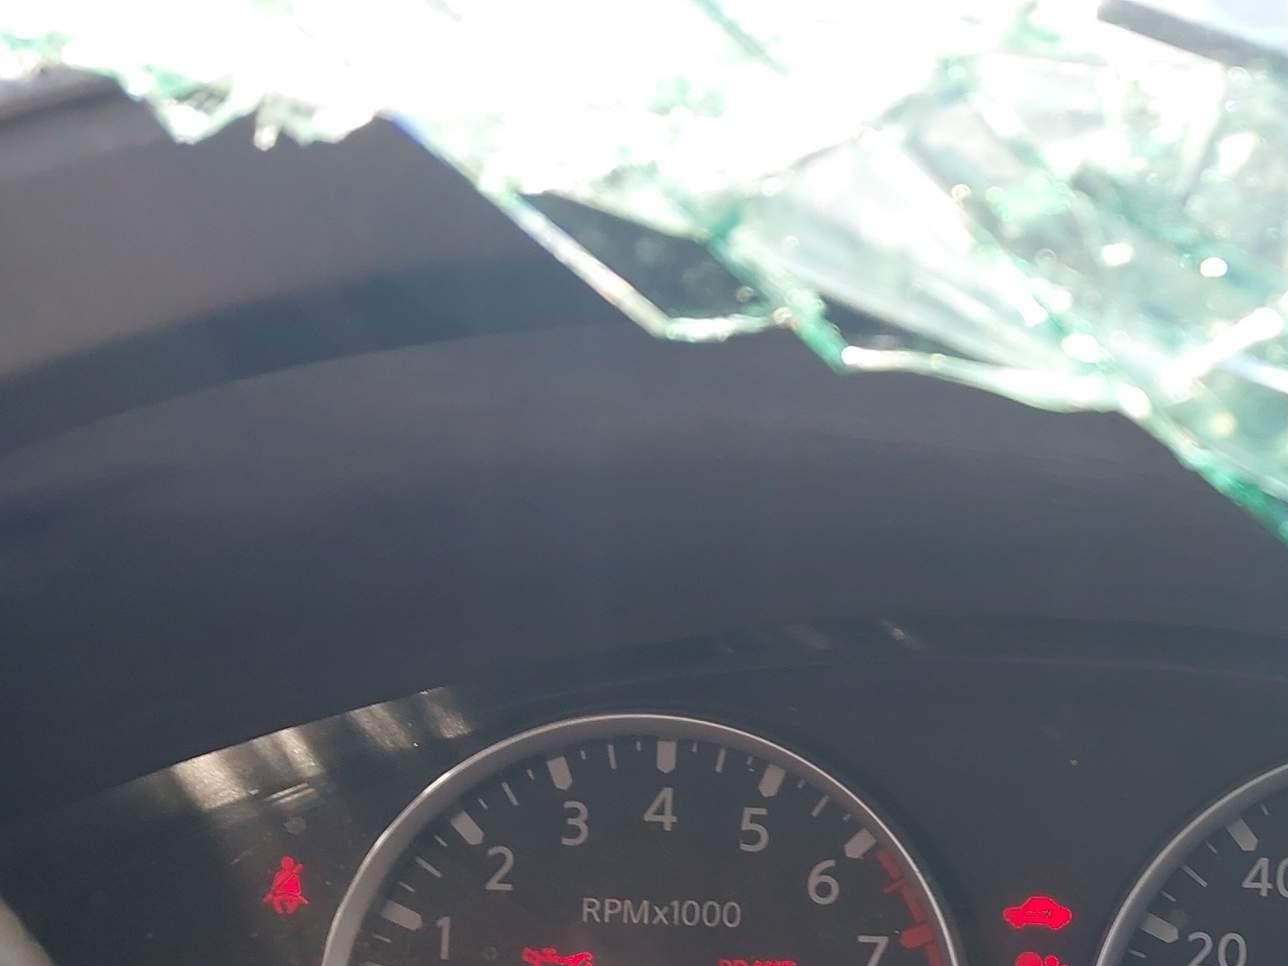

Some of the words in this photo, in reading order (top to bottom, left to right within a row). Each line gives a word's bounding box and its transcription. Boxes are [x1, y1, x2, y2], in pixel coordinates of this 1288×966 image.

[561, 801, 589, 846] 3
[643, 787, 678, 831] 4
[739, 807, 770, 852] 5
[486, 847, 513, 891] 2
[807, 860, 839, 904] 6
[581, 898, 741, 929] RPMx1000
[436, 917, 452, 960] 1
